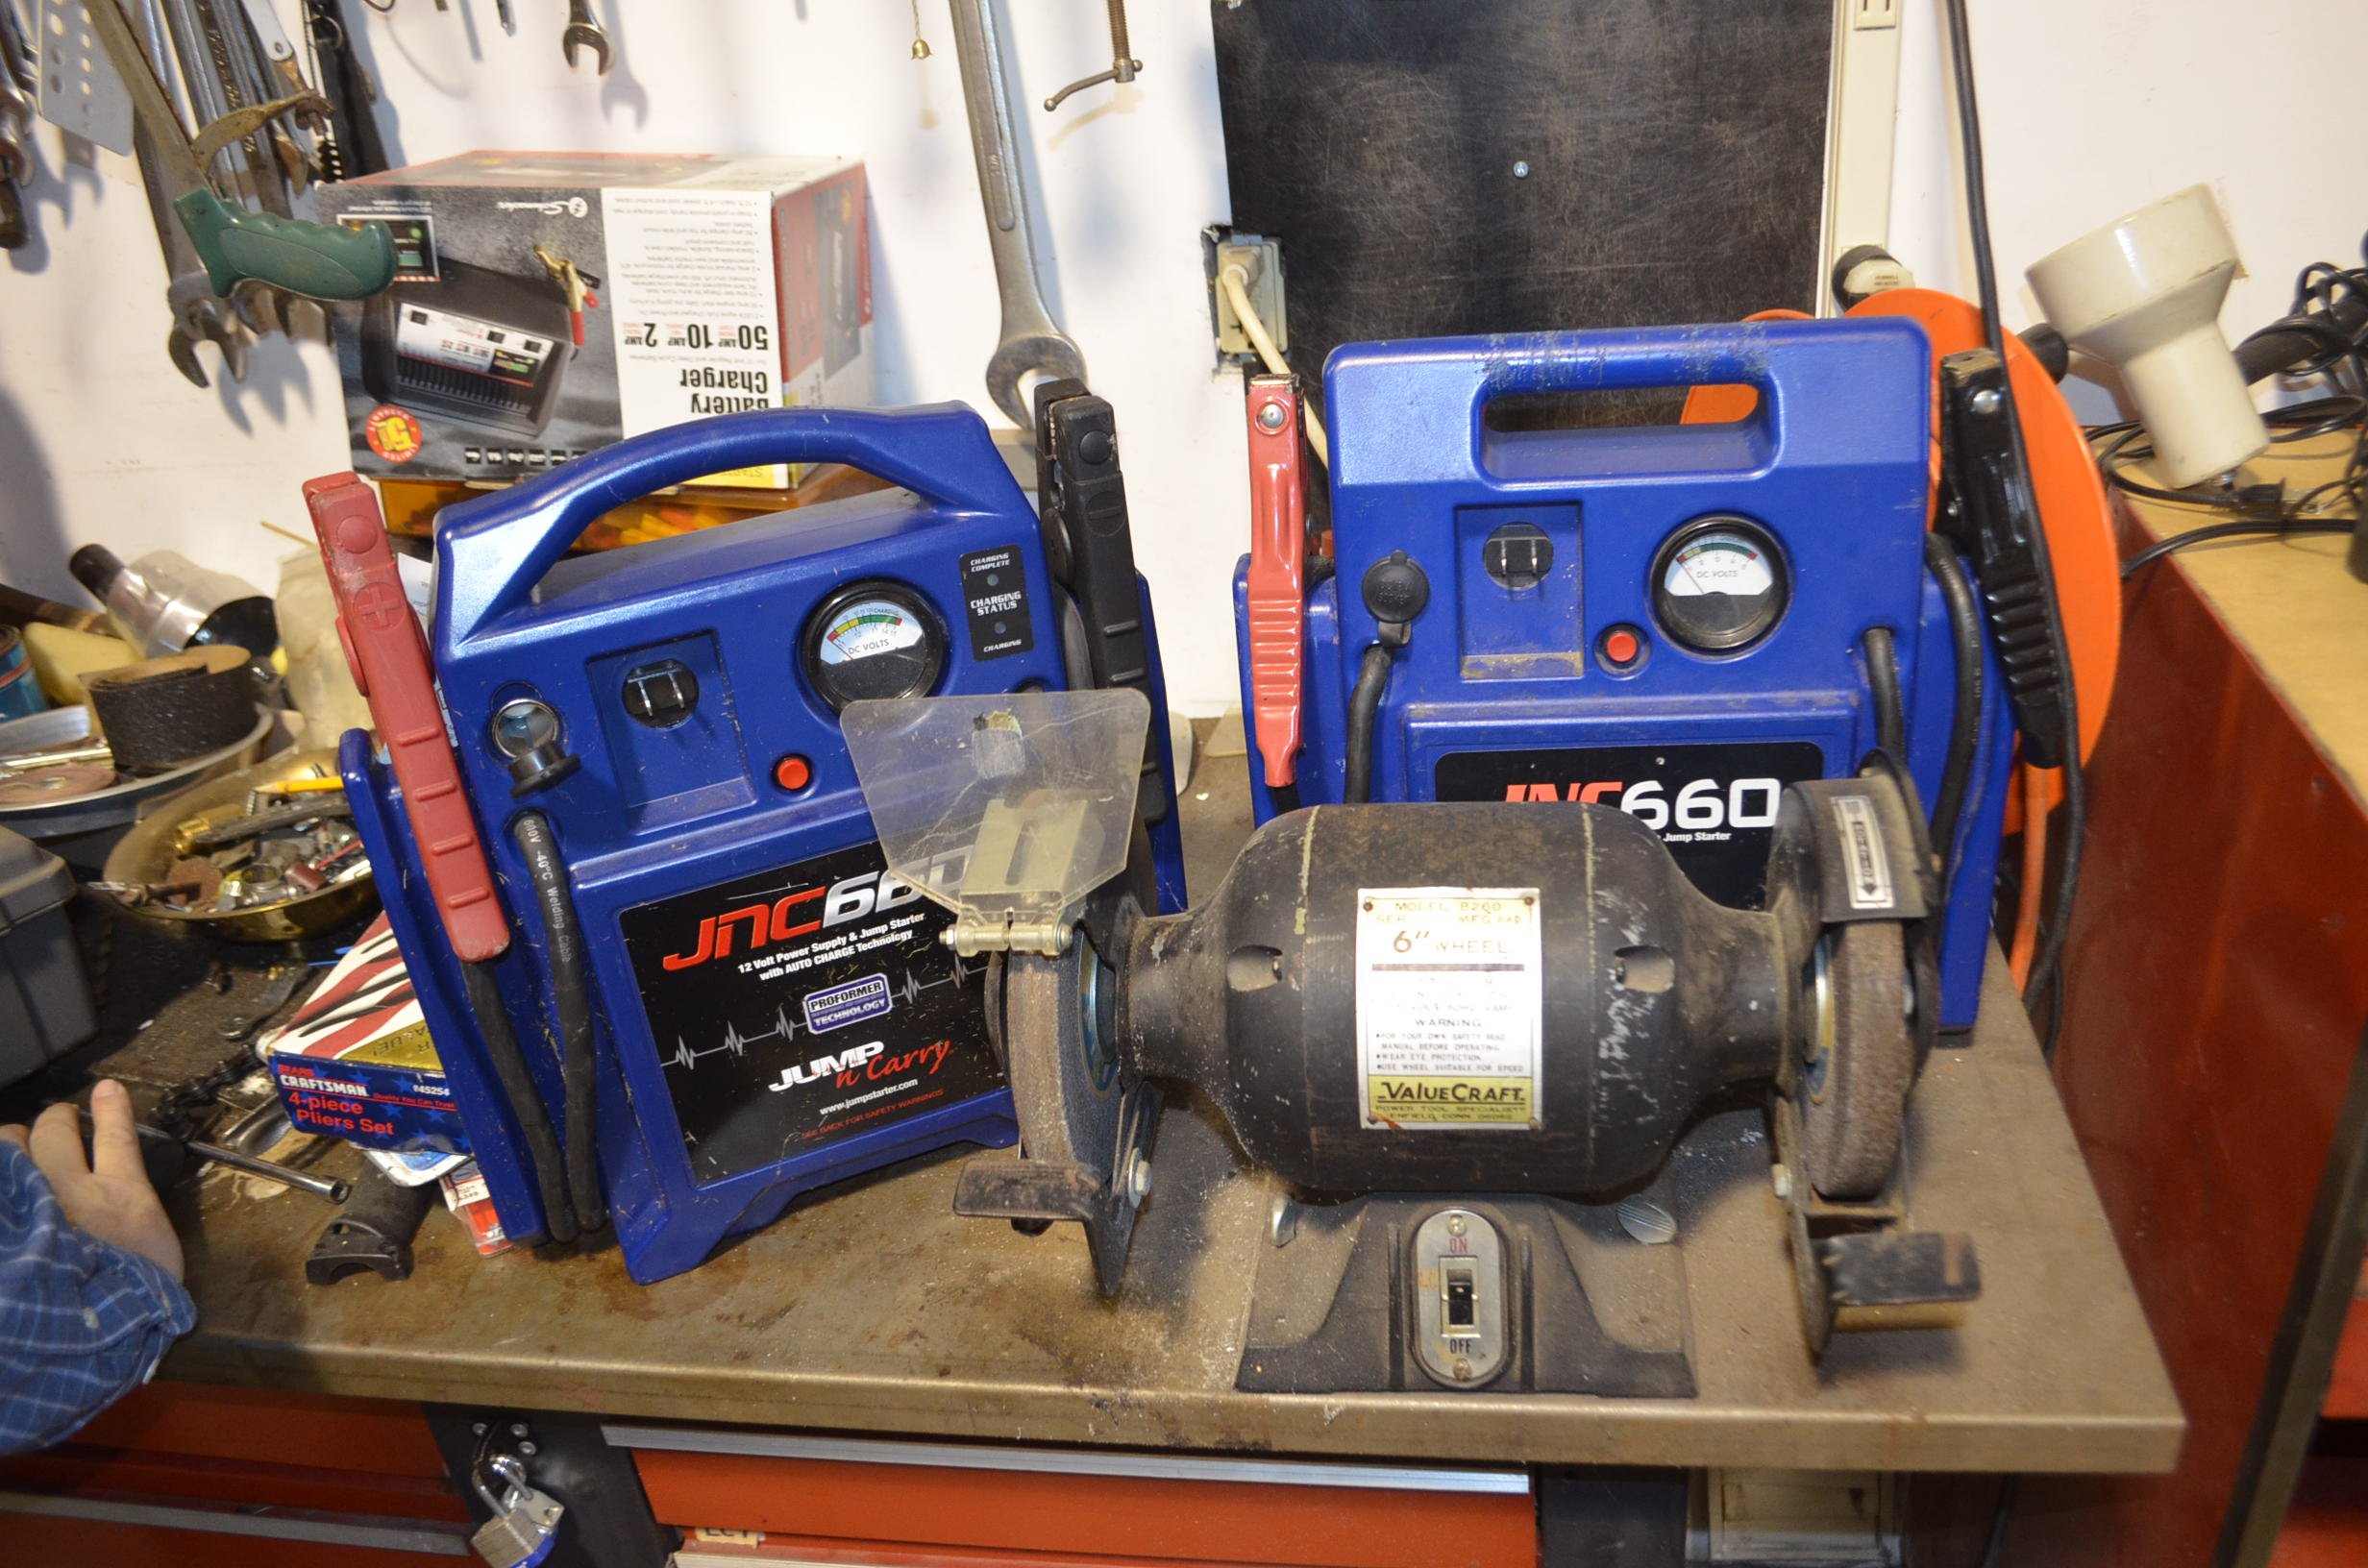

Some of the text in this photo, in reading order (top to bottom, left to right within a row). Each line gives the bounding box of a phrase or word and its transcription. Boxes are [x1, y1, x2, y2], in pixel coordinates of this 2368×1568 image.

[624, 335, 642, 346] AMP
[644, 322, 658, 347] 2
[667, 336, 685, 347] AMP
[687, 324, 714, 350] 10
[718, 337, 737, 348] AMP
[738, 326, 769, 351] 50
[679, 367, 769, 394] Charger
[690, 393, 769, 414] Battery
[971, 552, 1010, 566] CHARGING
[971, 559, 1011, 574] COMPLETE
[1696, 570, 1739, 579] DC VOLTS
[970, 591, 1023, 610] CHARGING
[976, 600, 1019, 617] STATUS
[848, 638, 890, 655] DC VOLTS
[983, 638, 1023, 653] CHARGING
[1662, 831, 1733, 845] Jump Starter
[546, 886, 566, 930] Welding
[557, 934, 572, 964] Cable
[738, 913, 925, 974] 12 Volt Power Supply & Jump Starter
[1436, 940, 1509, 954] WHEEL
[759, 929, 914, 982] with AUTO CHARGE Technology
[810, 982, 883, 1011] PROFORMER
[813, 997, 886, 1027] TECHNOLOGY
[1415, 1017, 1483, 1028] WARNING
[768, 1041, 886, 1092] JUMP
[866, 1039, 951, 1081] Carry
[280, 1074, 369, 1097] CRAFTSMAN
[288, 1091, 364, 1115] 4-piece
[819, 1078, 920, 1116] www.jumpstarter.com
[296, 1109, 395, 1136] Pliers Set
[820, 1119, 846, 1135] BACK
[845, 1114, 866, 1127] FOR
[866, 1104, 899, 1120] SAFETY
[1448, 1237, 1469, 1254] ON
[1449, 1339, 1472, 1355] OFF
